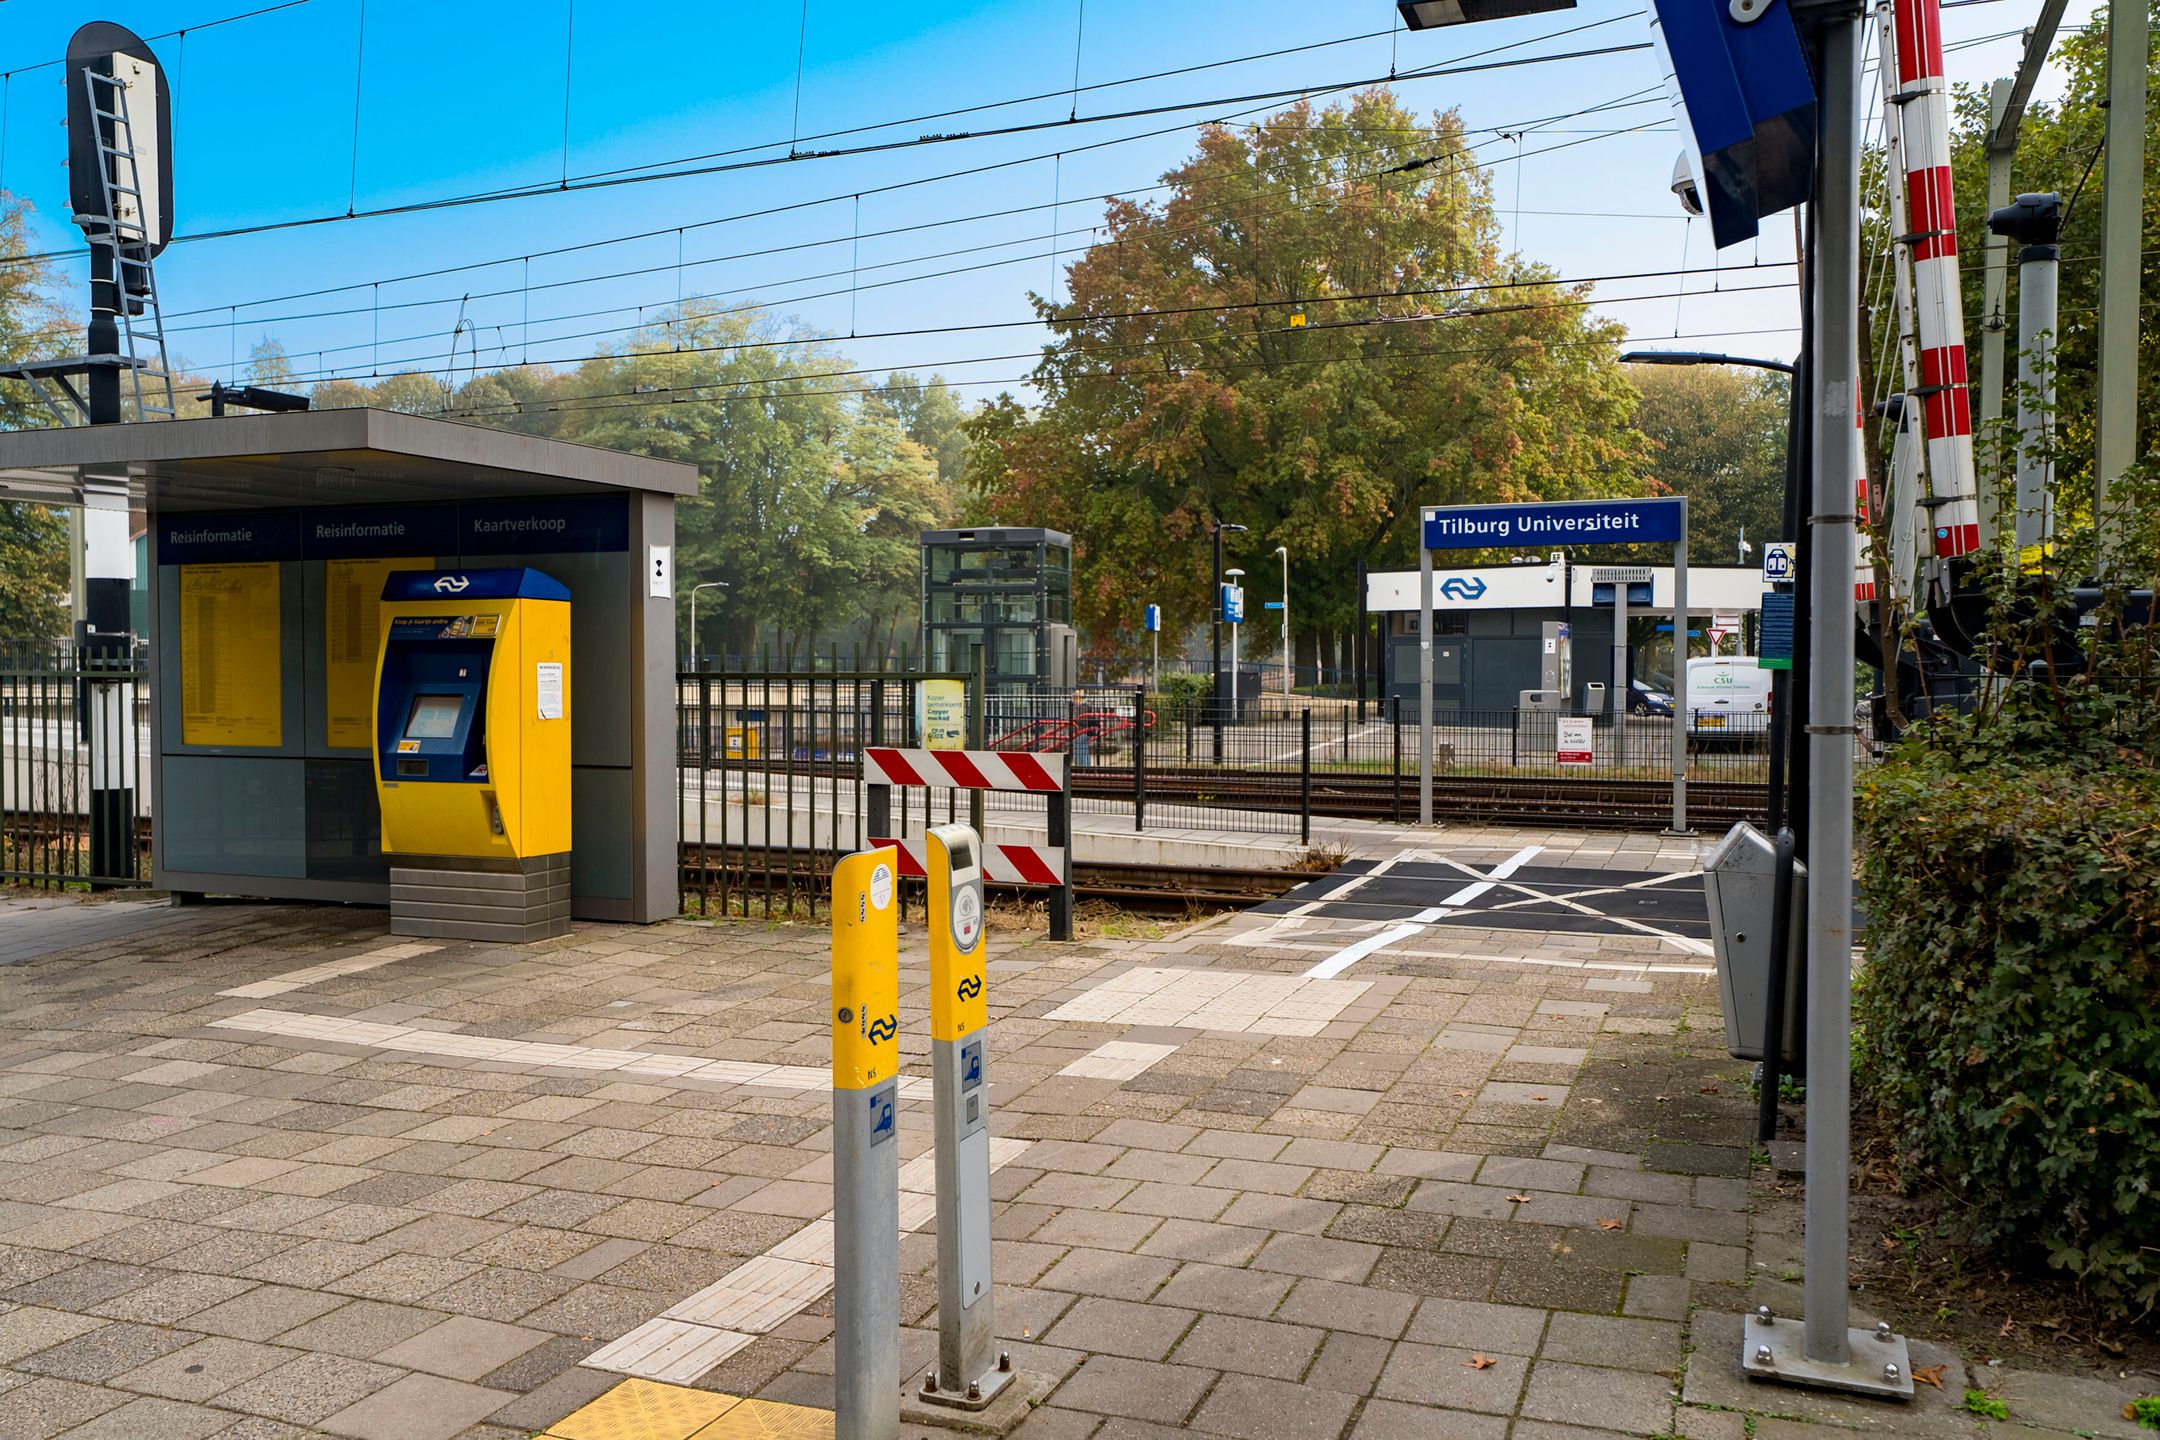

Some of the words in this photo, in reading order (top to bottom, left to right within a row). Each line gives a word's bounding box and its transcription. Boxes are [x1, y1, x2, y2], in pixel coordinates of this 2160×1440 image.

[316, 521, 405, 538] Reisinformatie
[474, 515, 566, 533] Kaartverkoop
[1439, 518, 1510, 537] Tilburg
[1518, 512, 1639, 532] Universiteit
[170, 527, 253, 544] Reisinformatie
[957, 1023, 965, 1032] NS
[867, 1068, 877, 1080] NS
